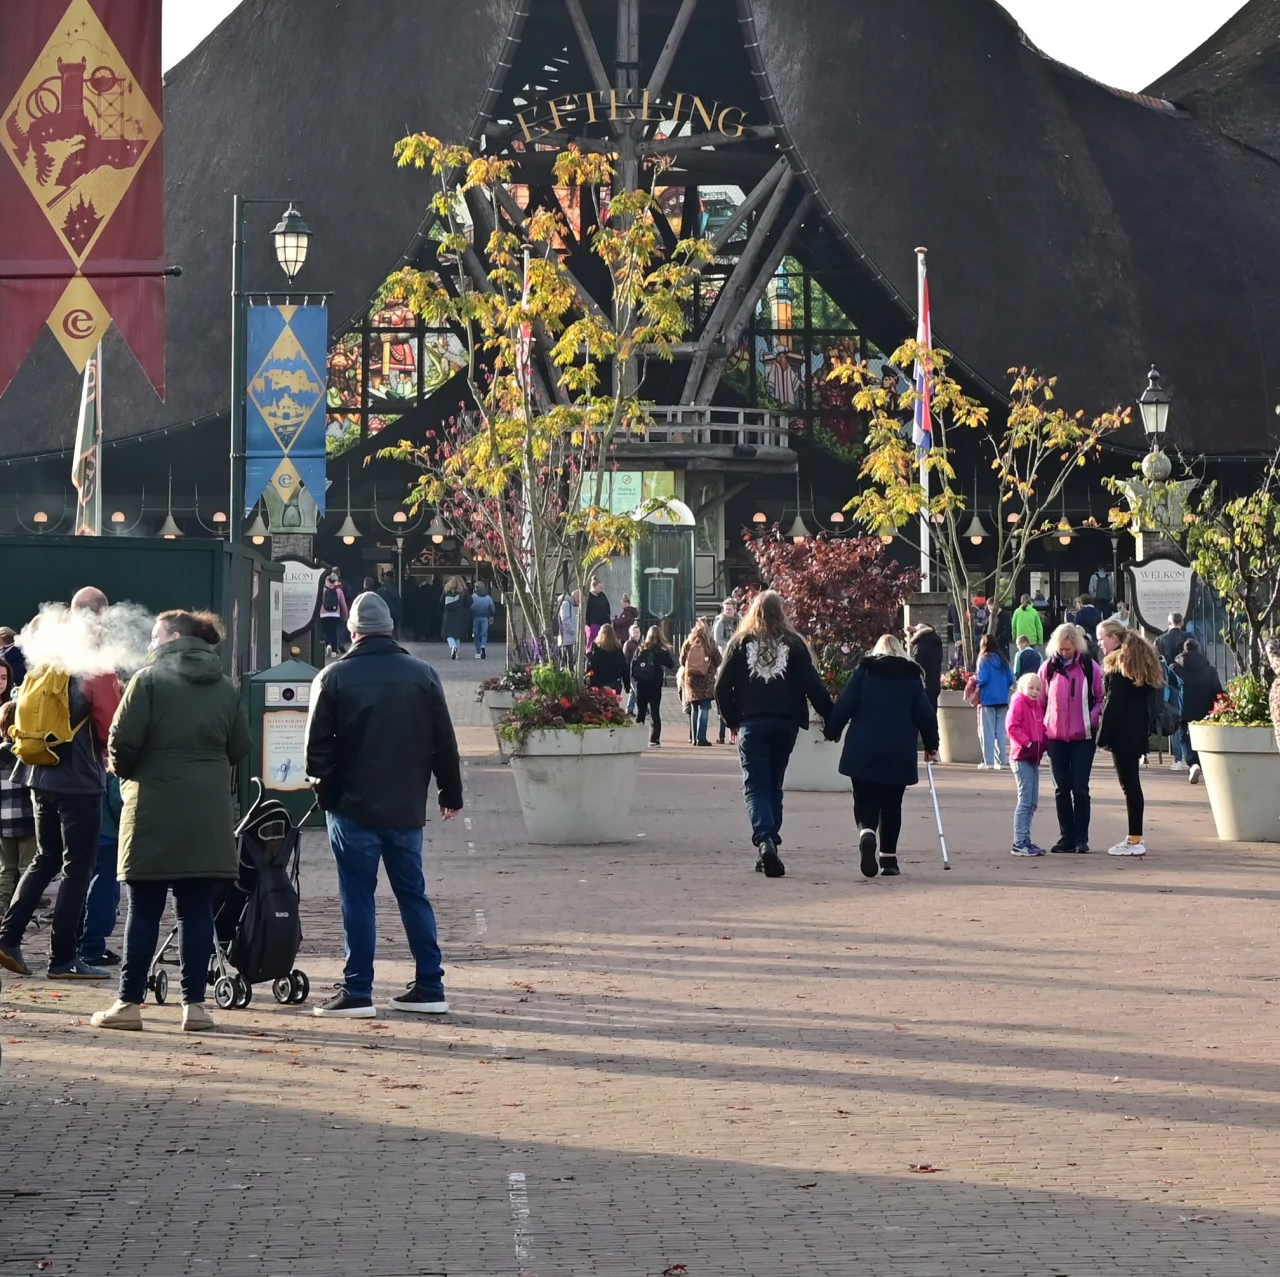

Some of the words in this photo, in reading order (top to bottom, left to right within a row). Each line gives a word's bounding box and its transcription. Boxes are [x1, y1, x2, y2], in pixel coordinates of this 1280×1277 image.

[516, 88, 748, 143] EFTELING
[284, 572, 313, 581] LKOM
[1140, 570, 1186, 579] WELKOM
